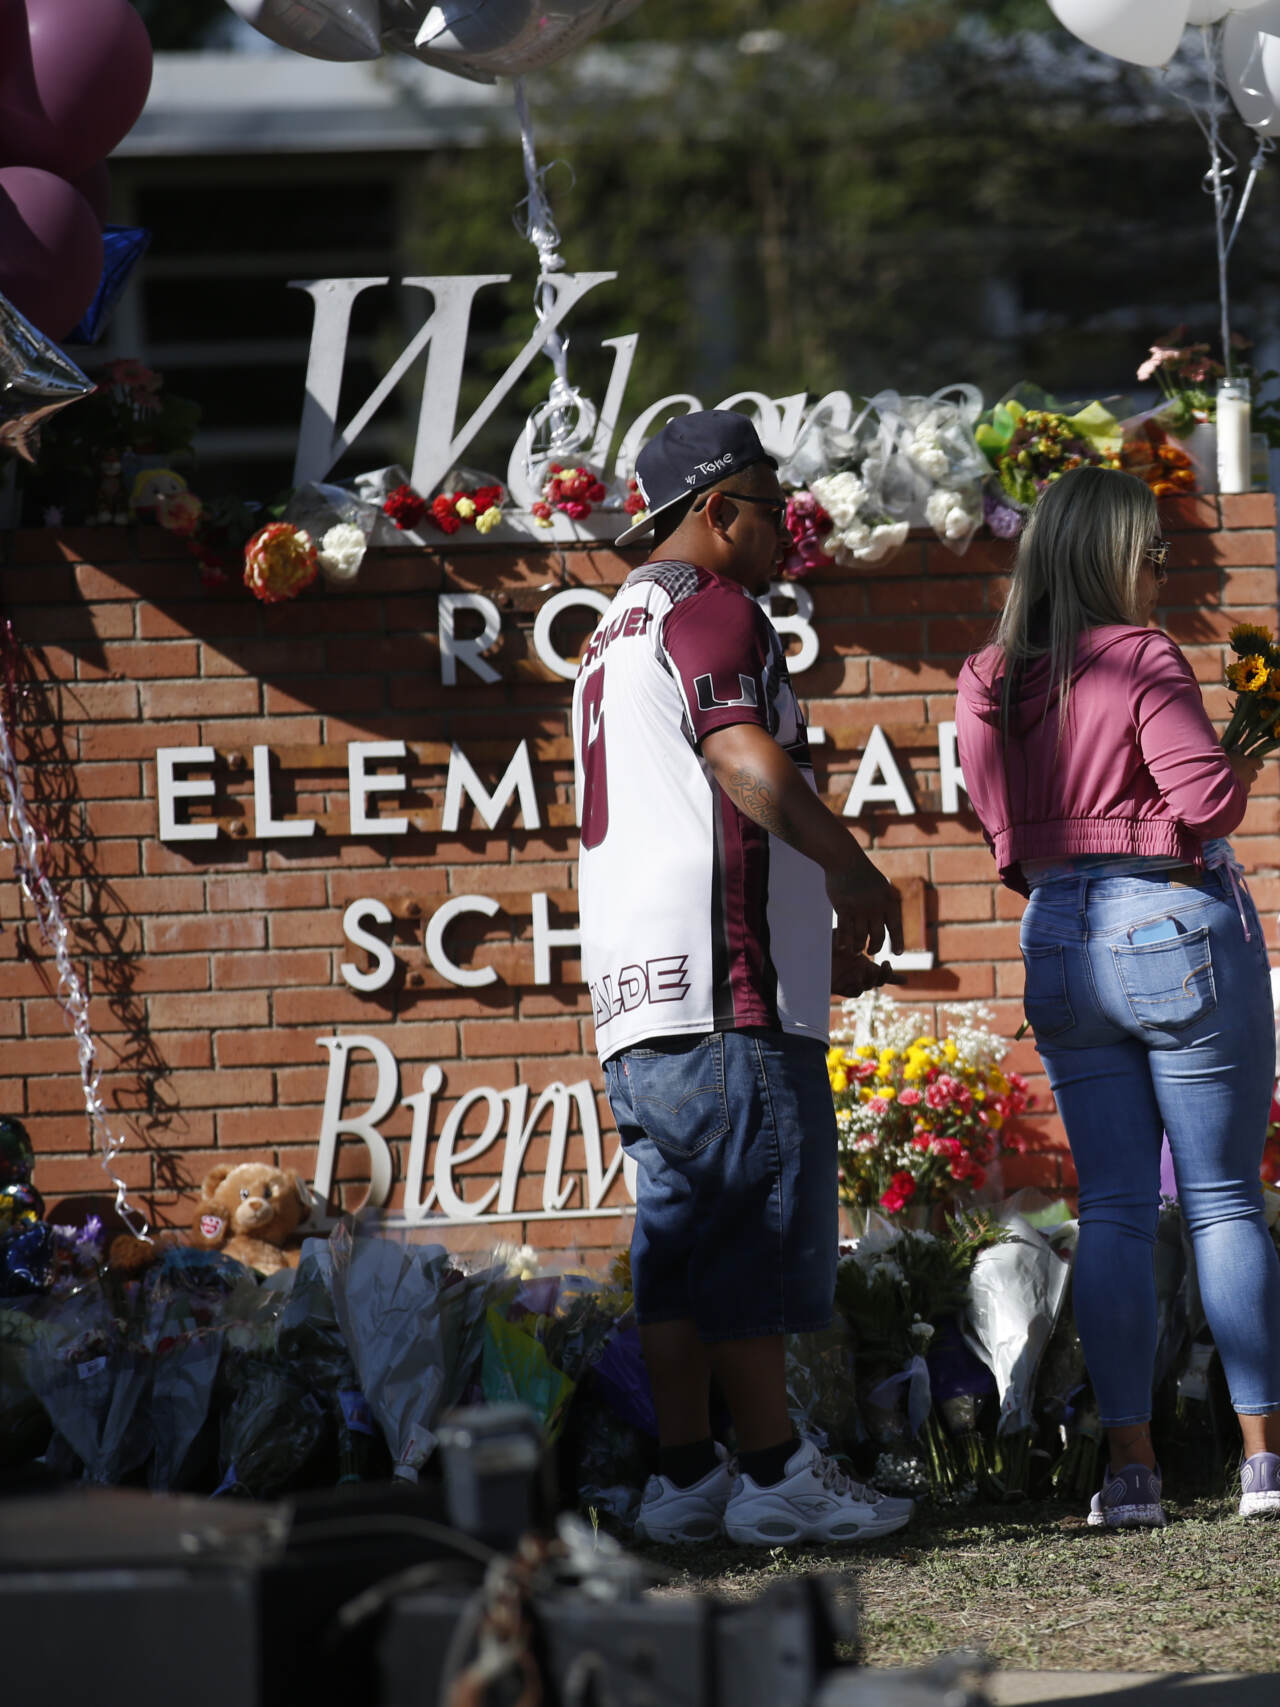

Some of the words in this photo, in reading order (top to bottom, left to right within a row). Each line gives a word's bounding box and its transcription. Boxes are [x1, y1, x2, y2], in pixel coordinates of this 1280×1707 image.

[694, 452, 733, 475] Tone
[439, 581, 820, 686] ROB
[693, 672, 759, 711] U
[590, 954, 692, 1029] ALDE
[308, 1034, 637, 1220] Bienv
